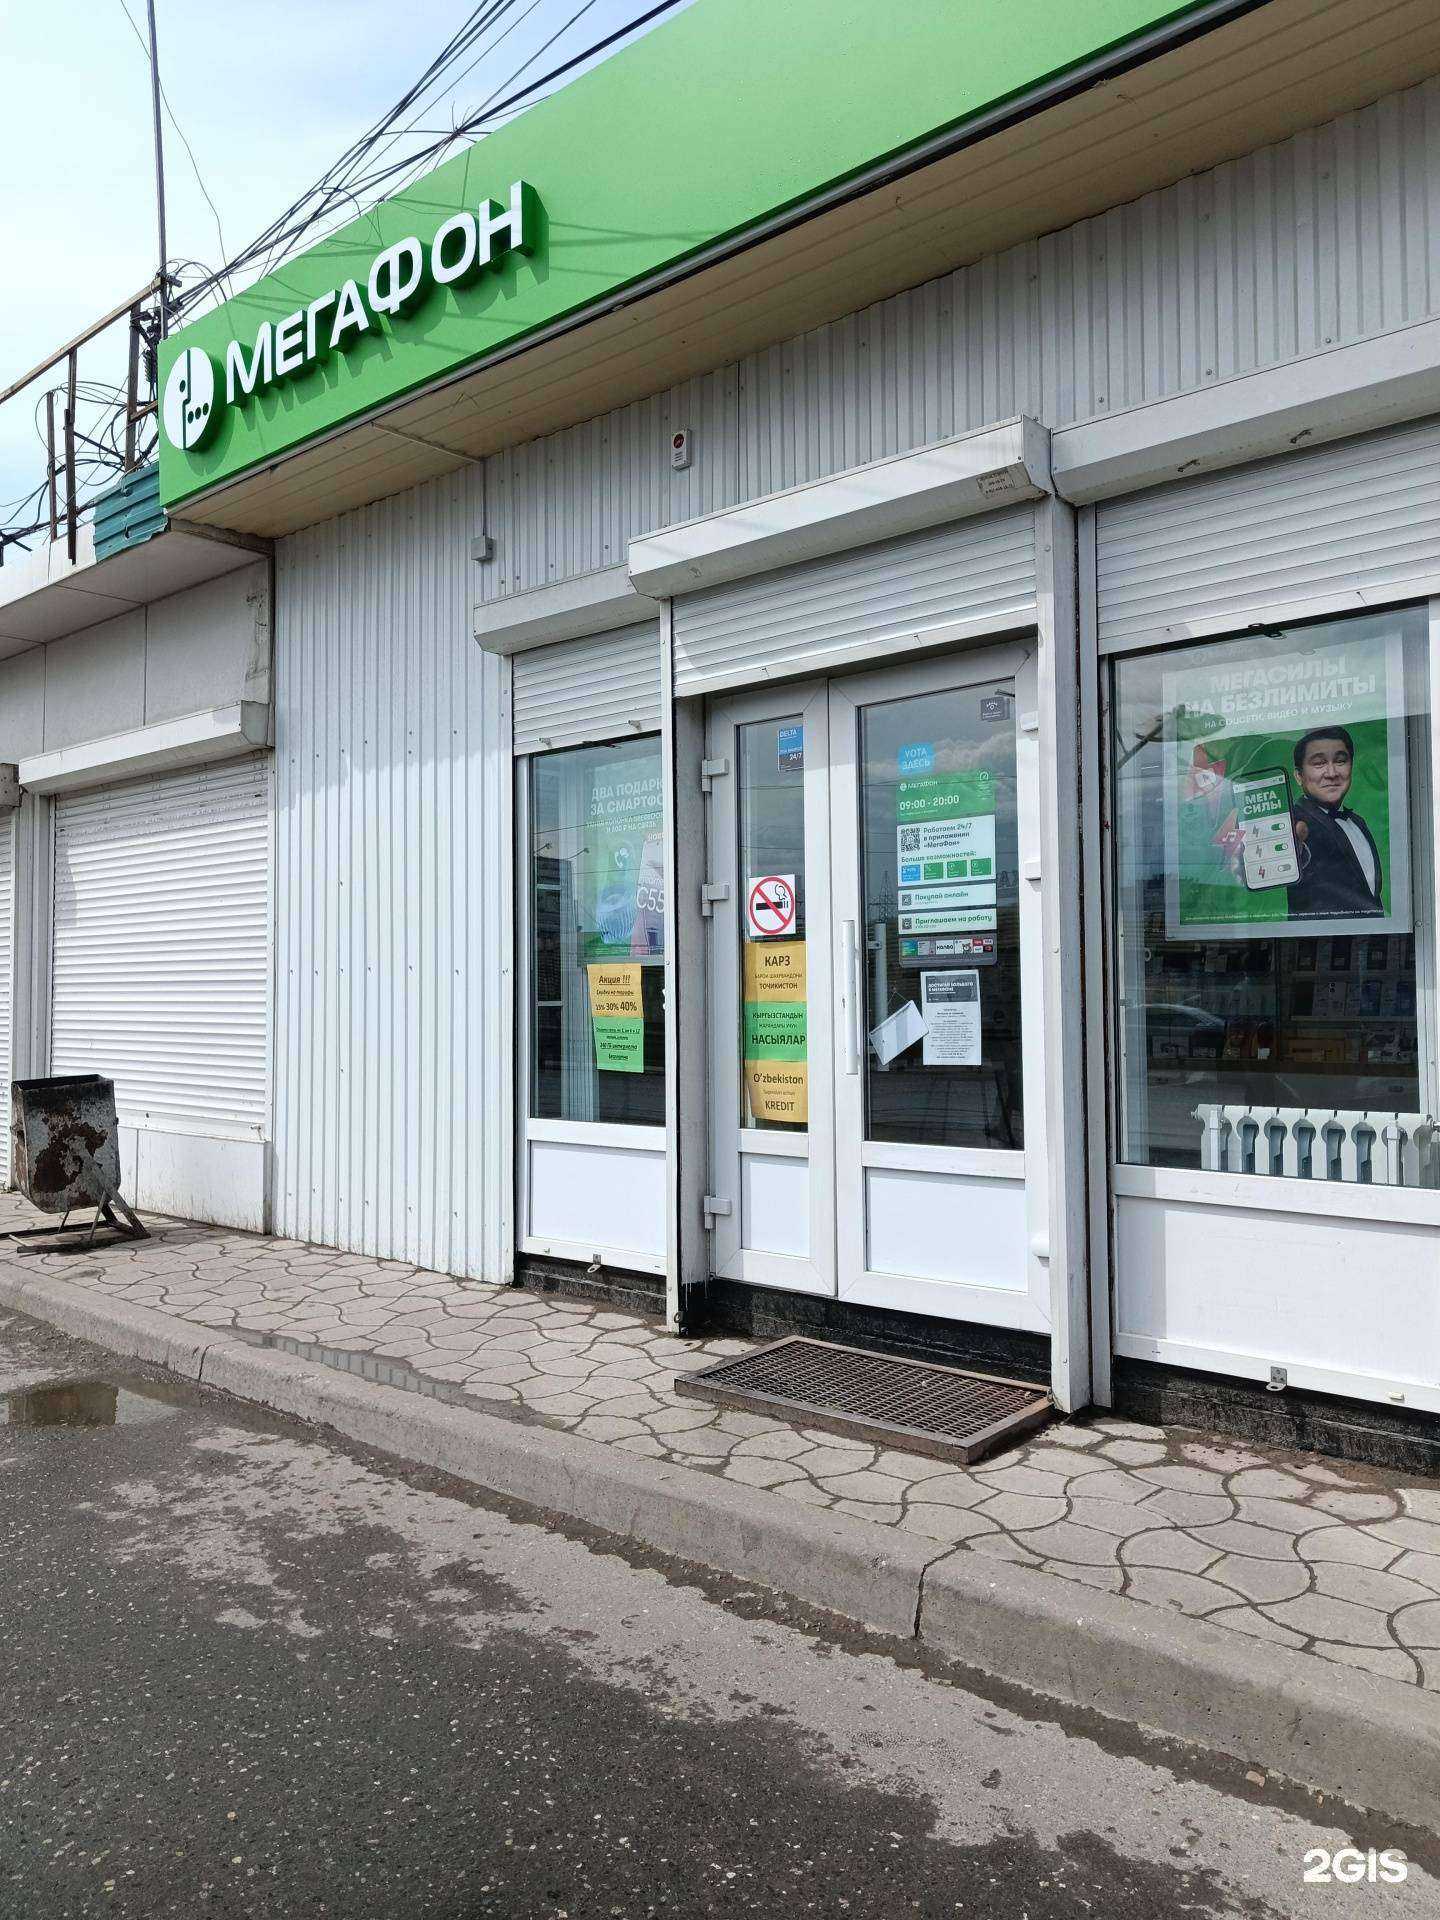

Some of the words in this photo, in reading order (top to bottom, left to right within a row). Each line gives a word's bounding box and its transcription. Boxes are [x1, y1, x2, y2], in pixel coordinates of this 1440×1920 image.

[226, 180, 530, 404] МЕГАФОН
[1210, 655, 1347, 693] МЕГАСИЛЫ
[1221, 675, 1376, 713] БЕЗЛИМИТЫ
[1268, 709, 1298, 720] ВИДЕО
[1311, 702, 1353, 714] МУЗЫКУ
[902, 759, 930, 770] ЗДЕСЬ
[592, 785, 614, 802] ДВА
[1245, 790, 1277, 805] МЕГА
[591, 802, 604, 816] ЗА
[900, 799, 925, 811] 09:00
[932, 795, 959, 807] 20:00
[1243, 799, 1281, 815] СИЛЫ
[923, 826, 955, 834] Работаем
[929, 832, 970, 842] приложении
[637, 886, 664, 913] C55
[915, 892, 942, 901] Покупай
[915, 917, 957, 925] Приглашаем
[968, 914, 992, 924] работу
[764, 955, 790, 967] КАРЗ
[599, 975, 620, 984] Акция
[606, 1003, 619, 1011] 30%
[620, 1001, 637, 1011] 40%
[752, 1034, 806, 1045] НАСЫЯЛАР
[765, 1100, 794, 1111] KREDIT
